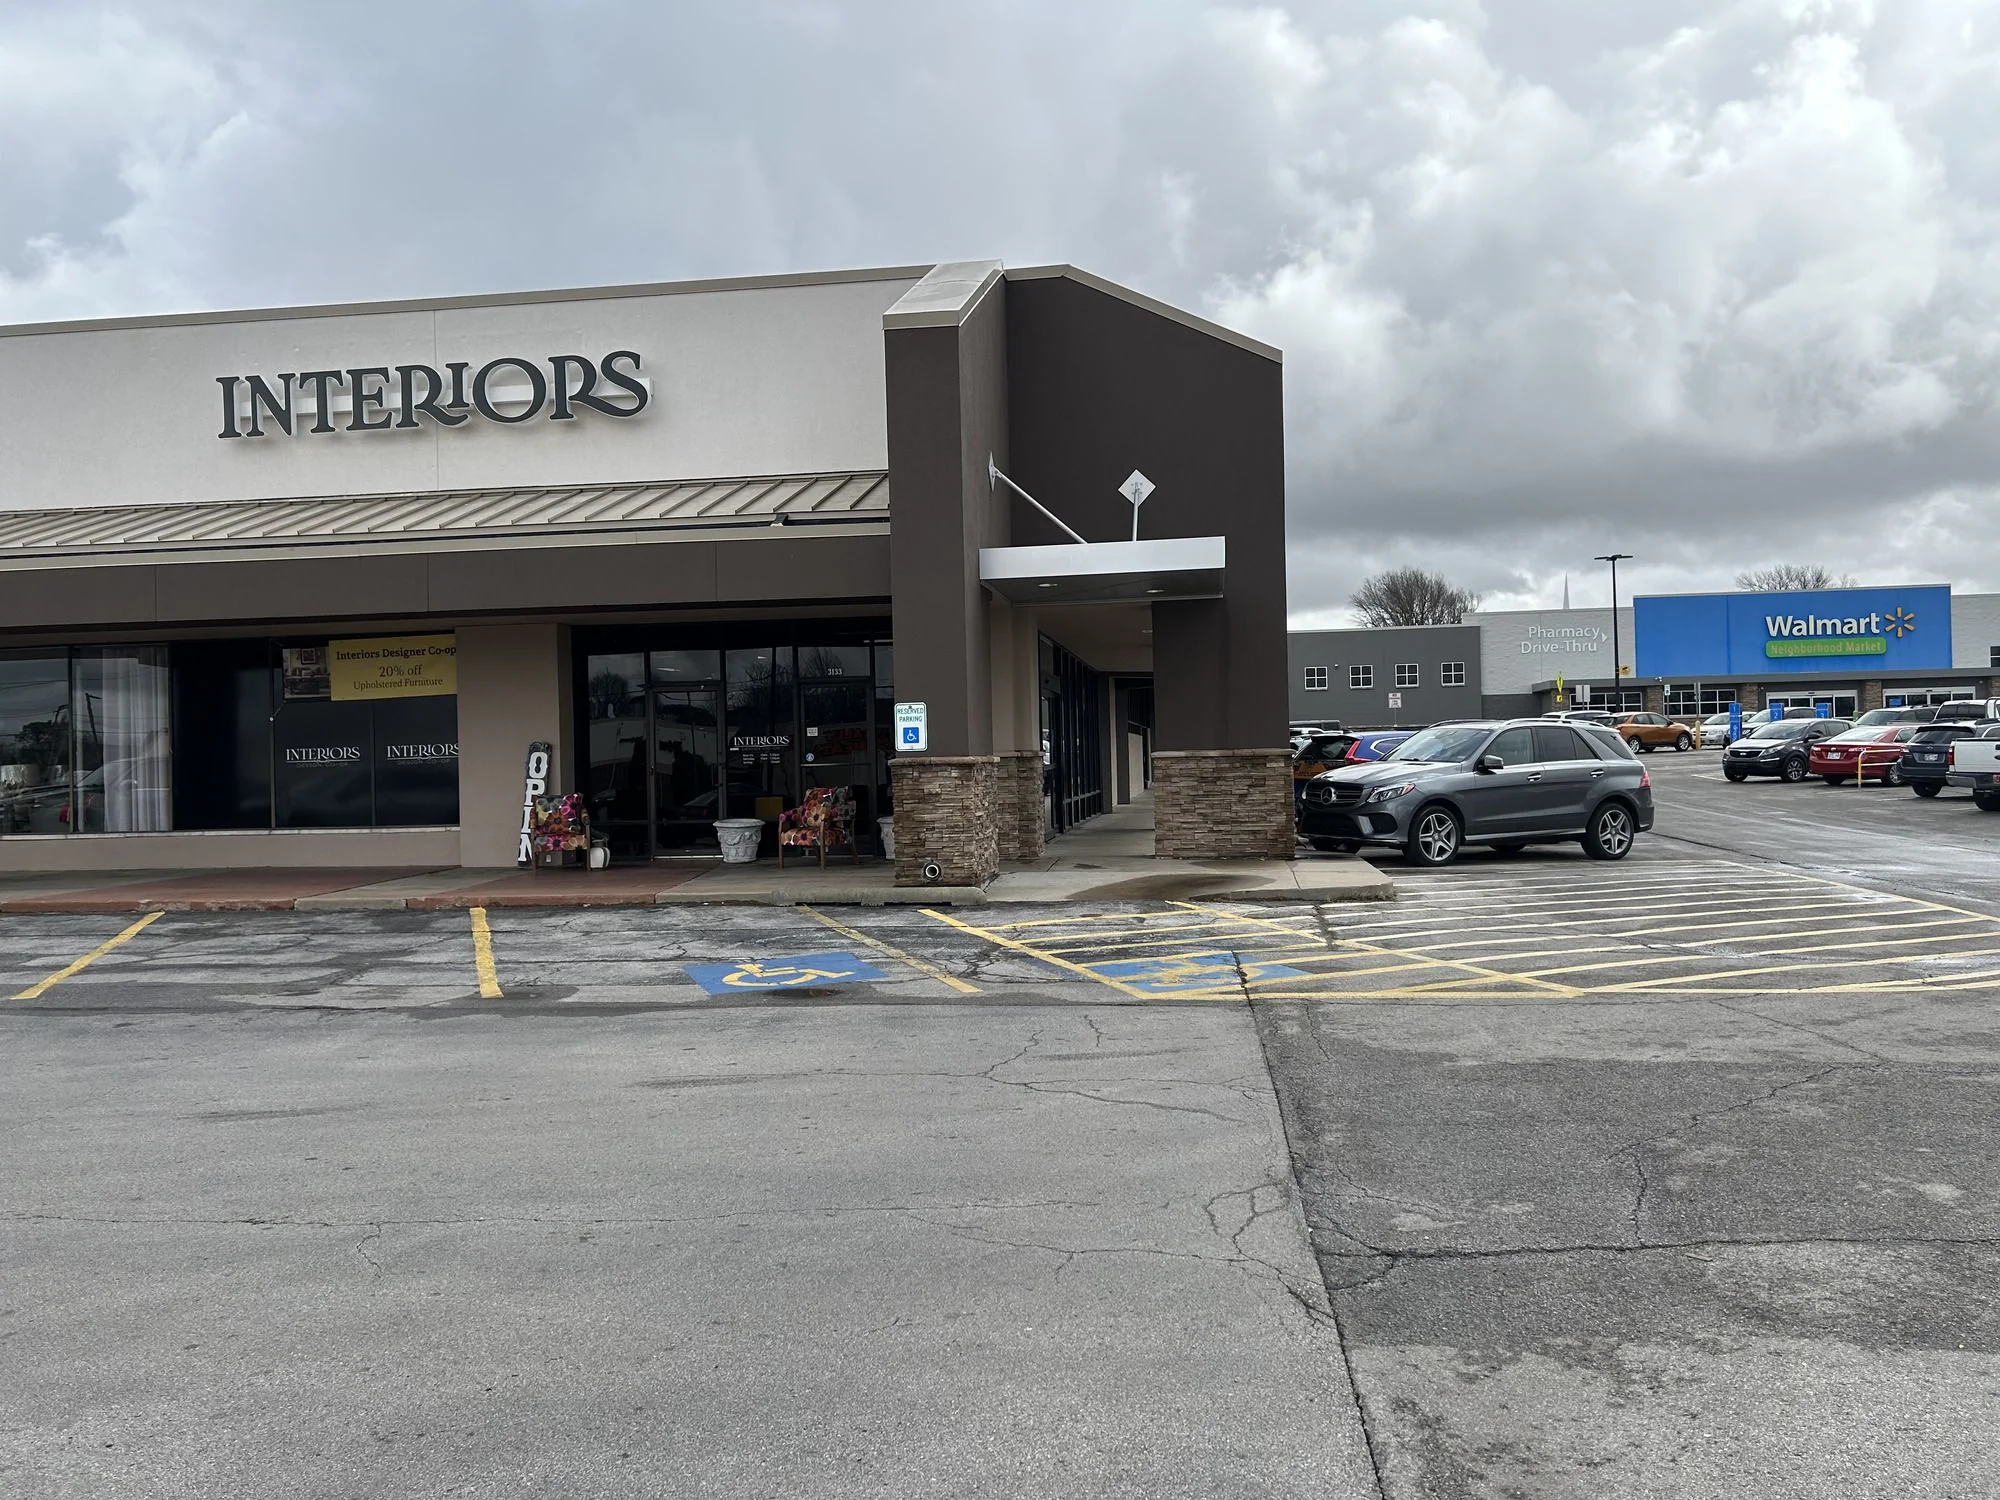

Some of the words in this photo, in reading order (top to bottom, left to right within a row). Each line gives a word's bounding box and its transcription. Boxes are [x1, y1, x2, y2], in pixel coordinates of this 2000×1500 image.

[216, 350, 648, 439] INTERIORS
[1765, 612, 1880, 637] Walmart
[1528, 626, 1600, 639] Pharmacy
[336, 649, 380, 660] Interiors
[382, 647, 426, 659] Designer
[428, 646, 457, 658] Co-op
[1521, 640, 1597, 654] Drive-Thru
[1771, 642, 1842, 656] Neighborhood
[1845, 641, 1882, 653] Market
[379, 665, 405, 677] 20%
[407, 664, 423, 676] off
[353, 678, 402, 692] Upholstered
[404, 677, 443, 687] Furniture
[897, 707, 924, 715] RESERVED
[734, 735, 790, 746] INTERIORS
[286, 746, 360, 761] INTERIORS
